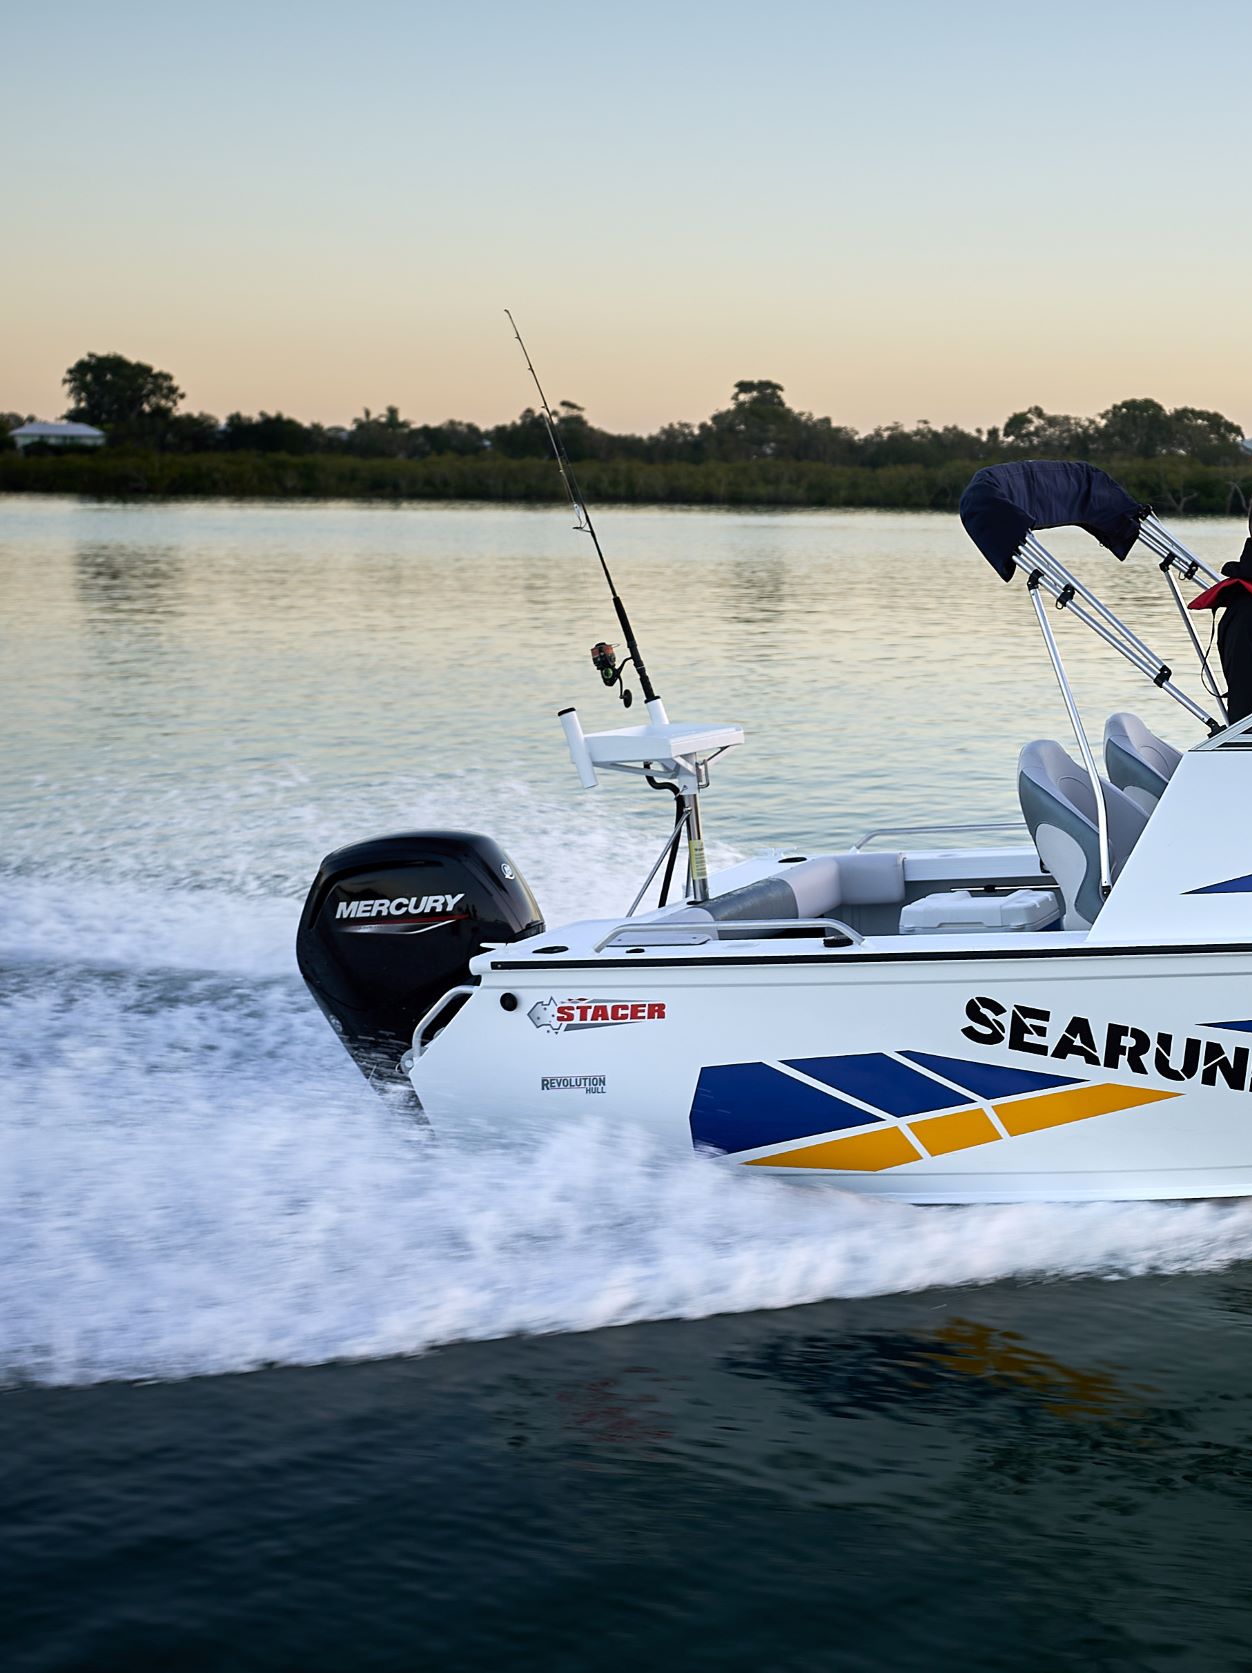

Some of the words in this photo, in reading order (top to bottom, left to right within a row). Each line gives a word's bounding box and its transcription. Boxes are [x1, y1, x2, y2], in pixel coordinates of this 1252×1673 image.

[335, 893, 465, 919] MERCURY
[556, 1002, 667, 1023] STACER
[541, 1077, 606, 1091] REVOLUTION
[585, 1086, 607, 1094] HULL
